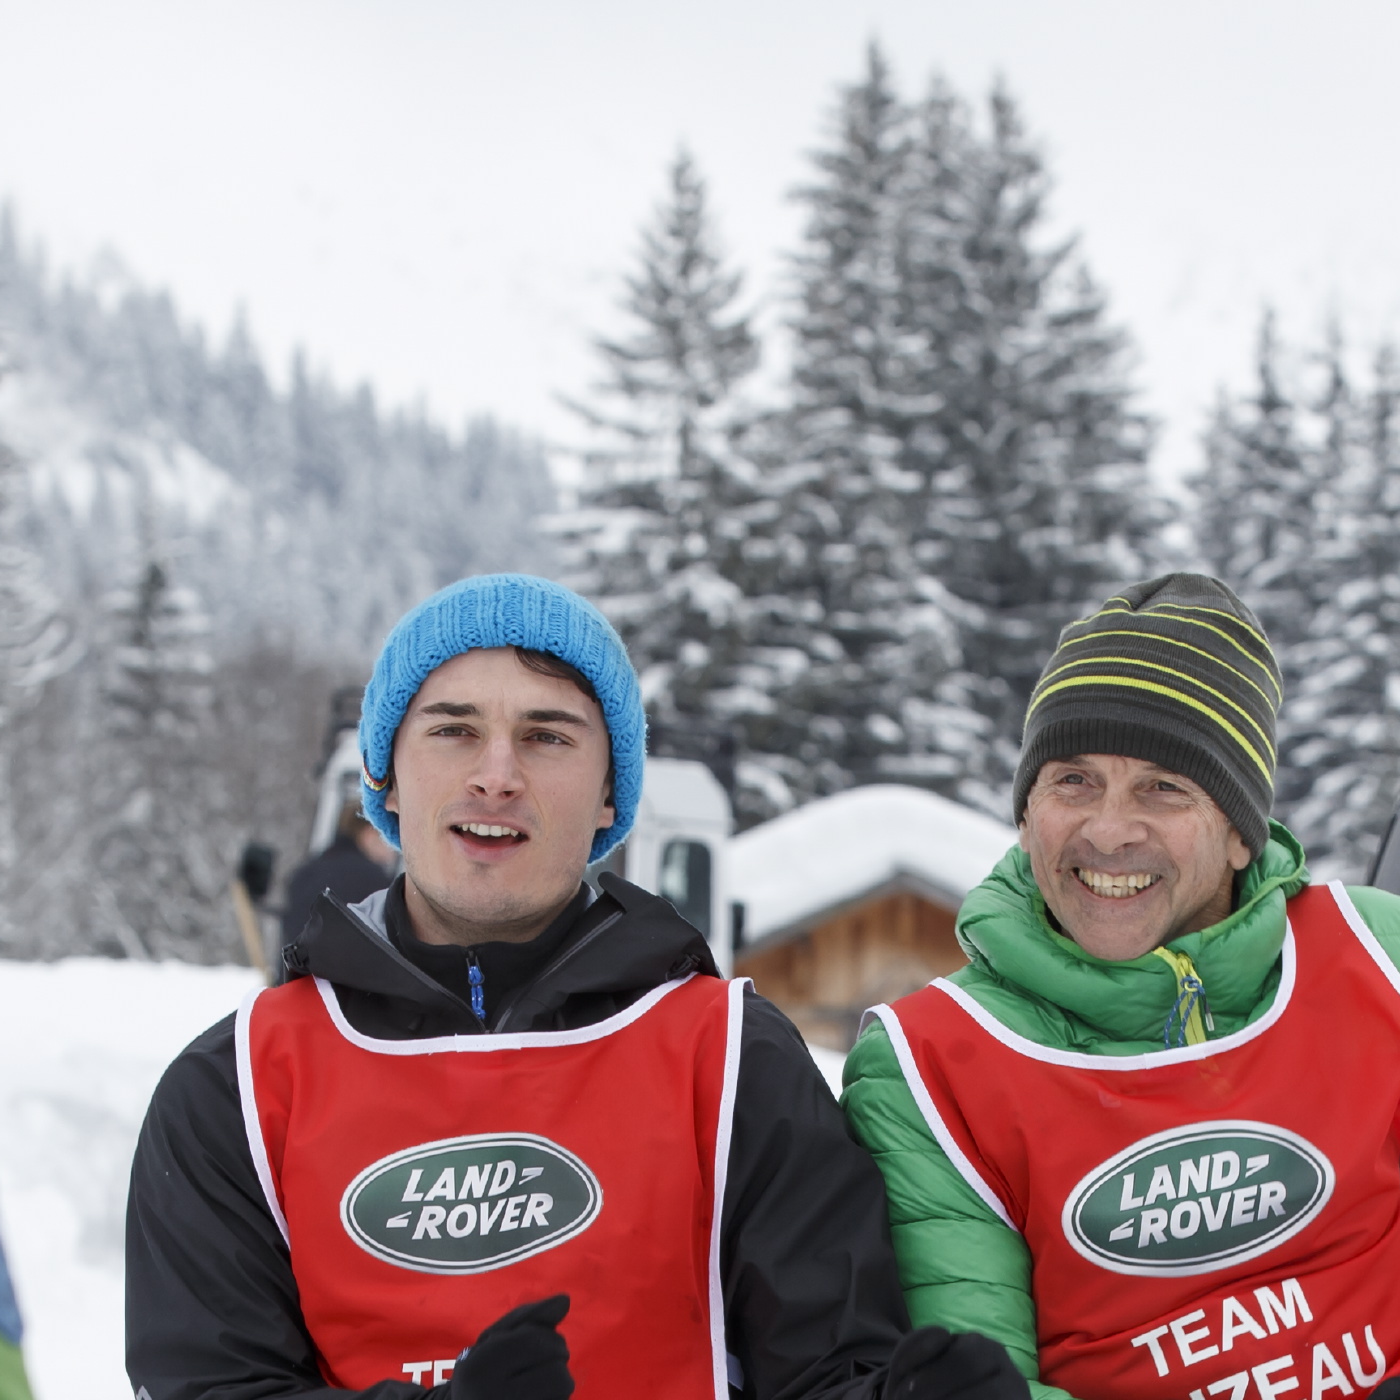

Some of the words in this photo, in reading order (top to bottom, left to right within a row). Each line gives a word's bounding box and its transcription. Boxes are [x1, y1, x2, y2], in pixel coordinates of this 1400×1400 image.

[402, 1160, 516, 1202] LAND
[1120, 1150, 1240, 1211] LAND
[412, 1193, 553, 1240] ROVER
[1138, 1181, 1287, 1248] ROVER
[1131, 1277, 1313, 1377] TEAM
